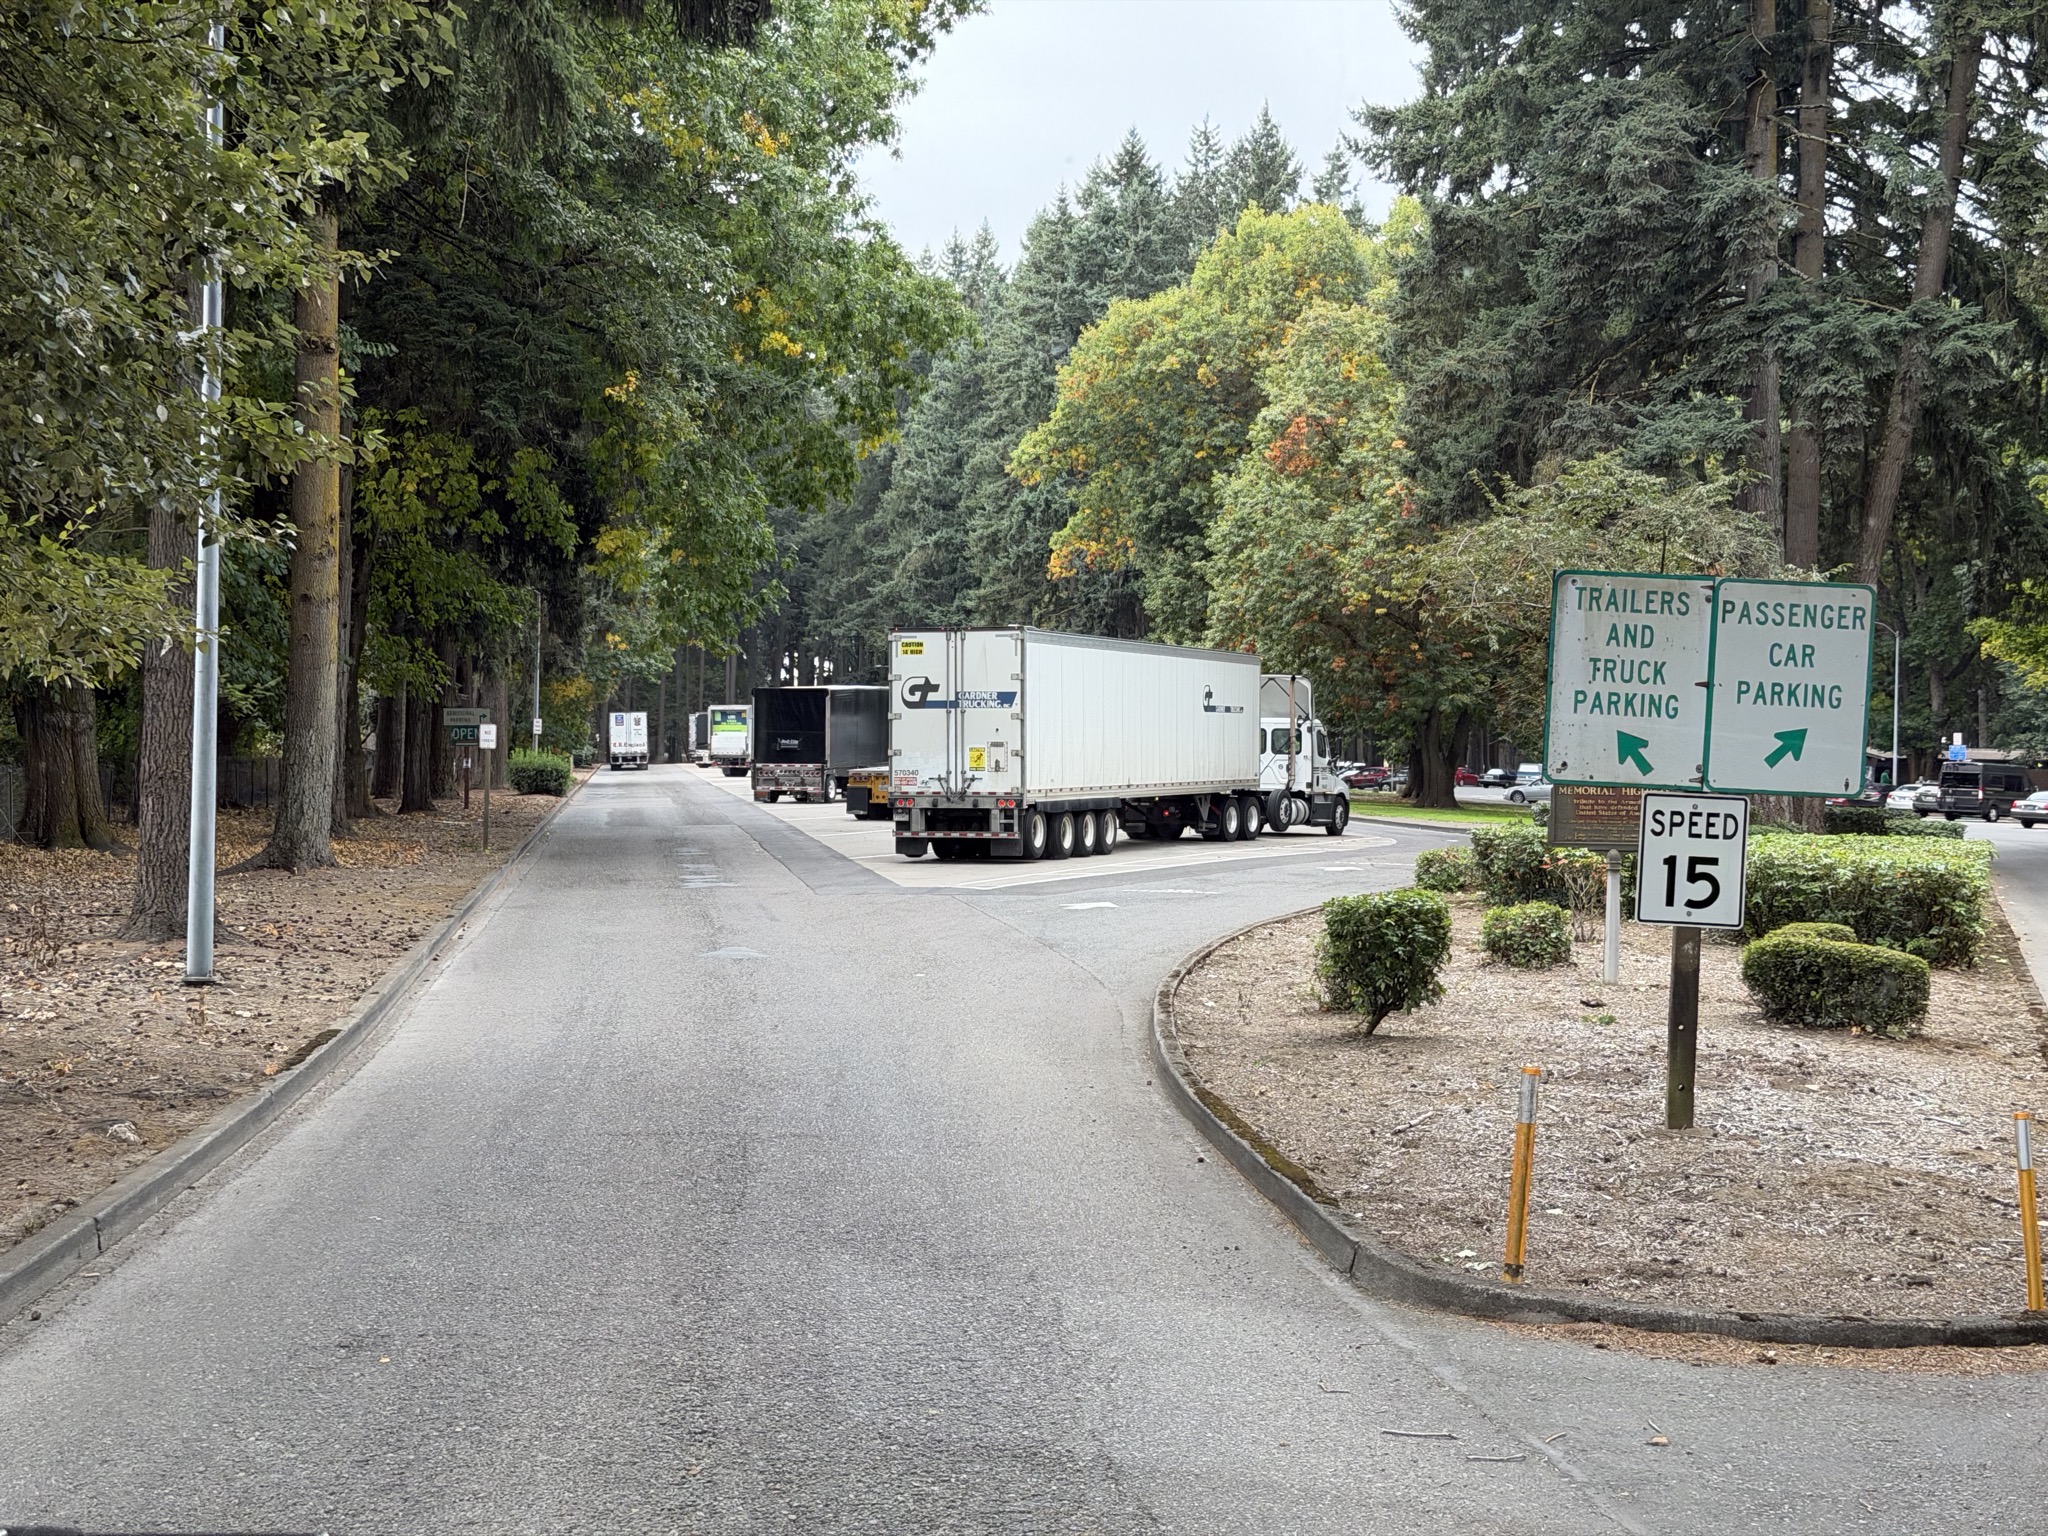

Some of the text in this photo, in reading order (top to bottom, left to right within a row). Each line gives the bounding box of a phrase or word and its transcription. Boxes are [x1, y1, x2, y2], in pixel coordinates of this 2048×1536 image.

[1575, 587, 1690, 616] TRAILERS
[1721, 600, 1866, 630] PASSENGER
[1606, 623, 1654, 648] AND
[1769, 643, 1815, 668] CAR
[1589, 657, 1666, 685] TRUCK
[958, 691, 998, 700] GARDNER
[1573, 690, 1679, 719] PARKING
[1736, 680, 1842, 709] PARKING
[1558, 786, 1616, 796] MEMORIAL
[1650, 809, 1739, 840] SPEED
[1663, 855, 1720, 909] 15
